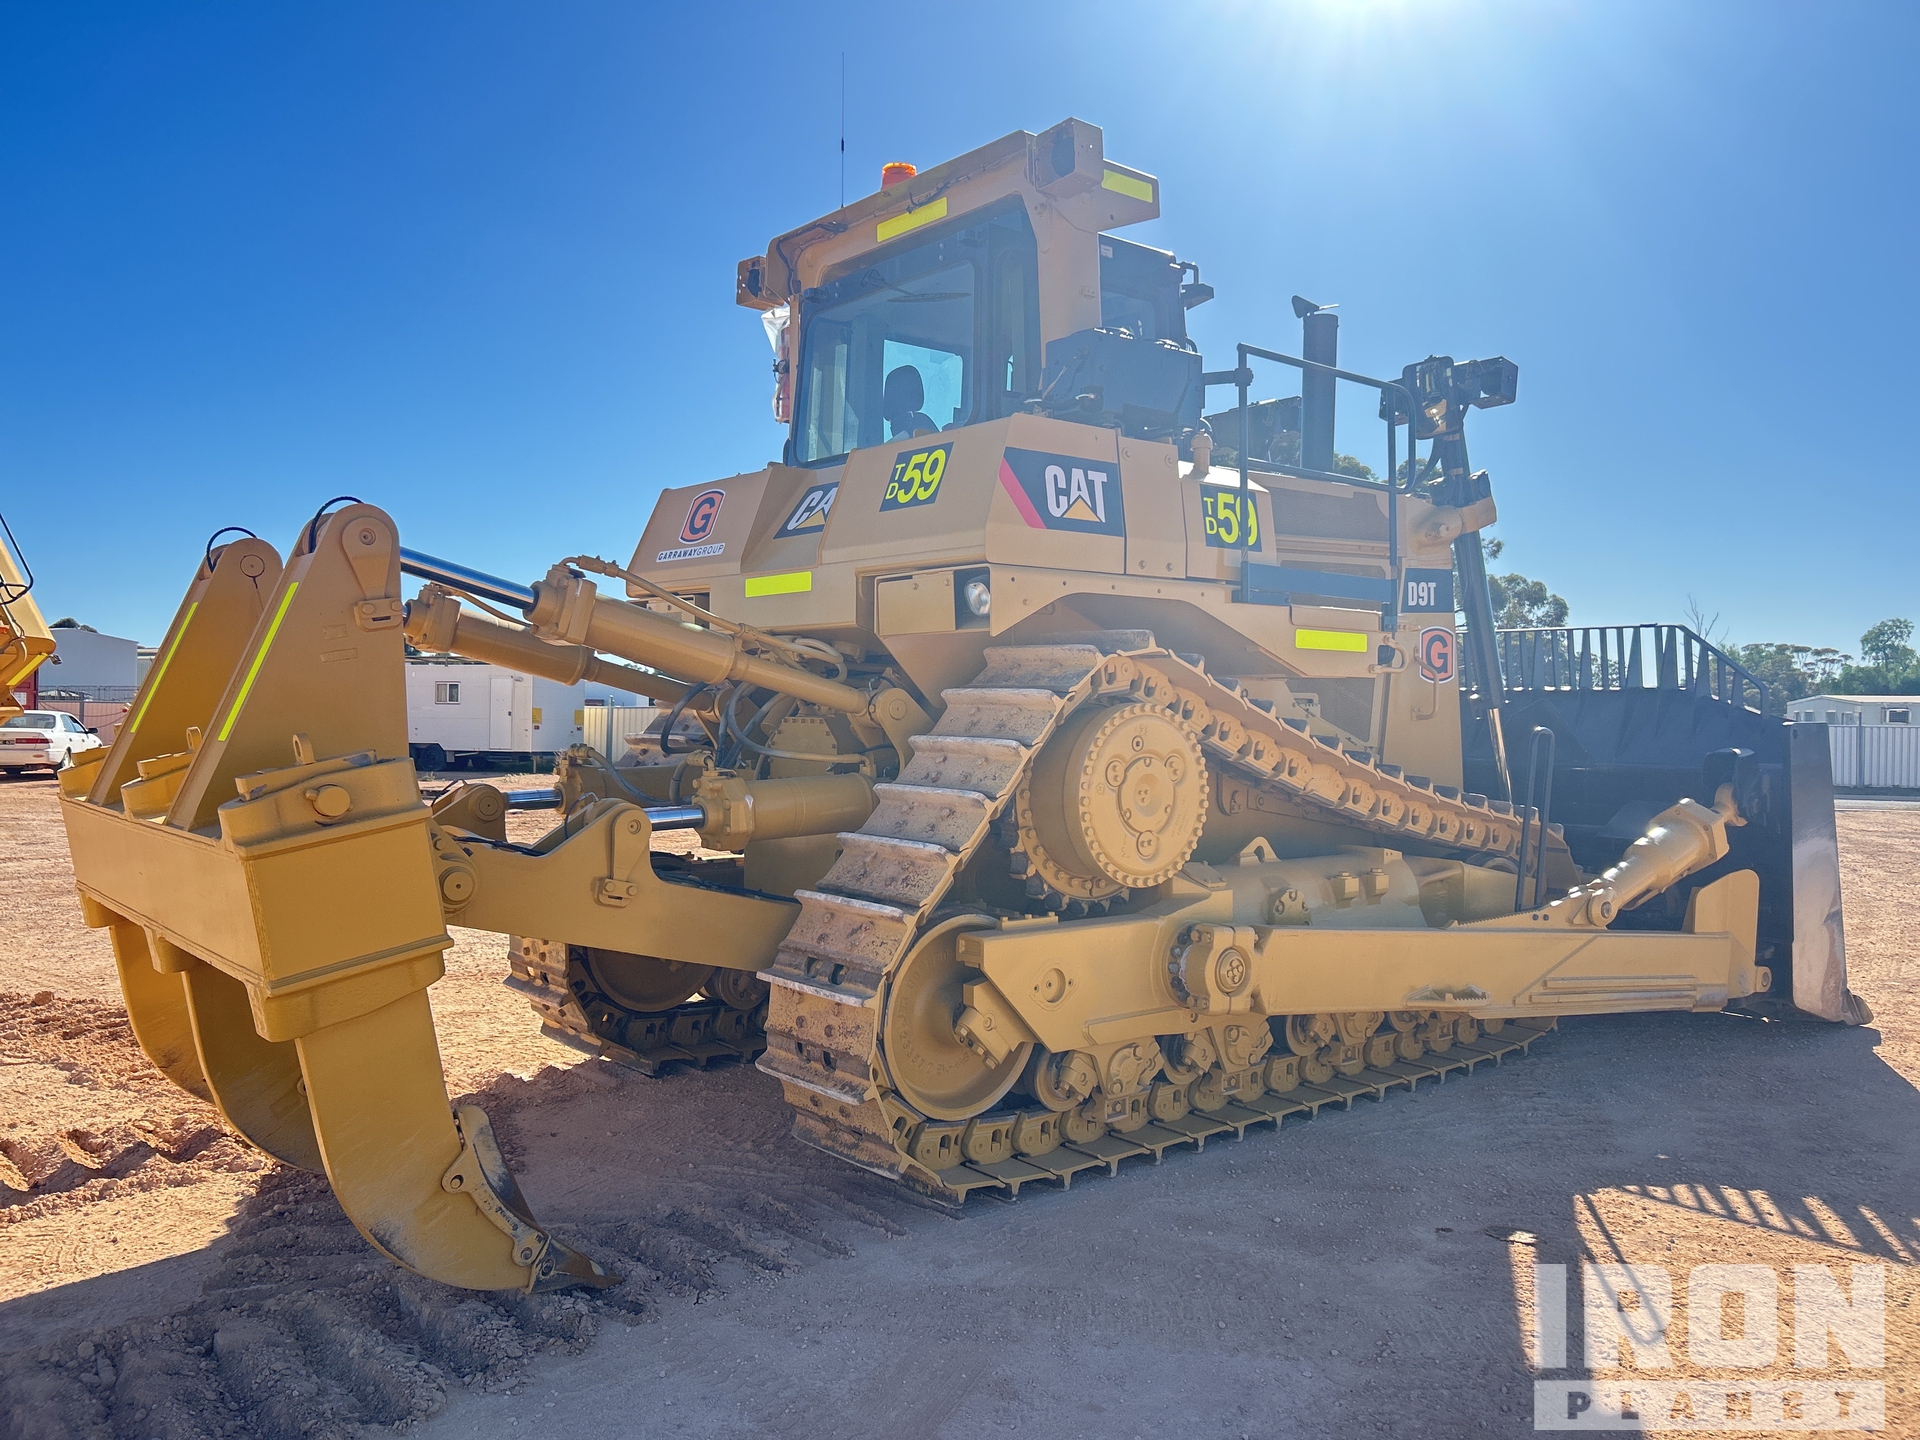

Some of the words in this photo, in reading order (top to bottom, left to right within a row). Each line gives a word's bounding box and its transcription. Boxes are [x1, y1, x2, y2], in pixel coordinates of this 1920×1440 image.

[897, 449, 946, 503] 59
[1045, 465, 1108, 523] CAT
[688, 496, 716, 536] G
[787, 486, 839, 531] CA
[1217, 492, 1257, 546] 59
[1407, 581, 1437, 606] D9T
[1425, 634, 1448, 674] G
